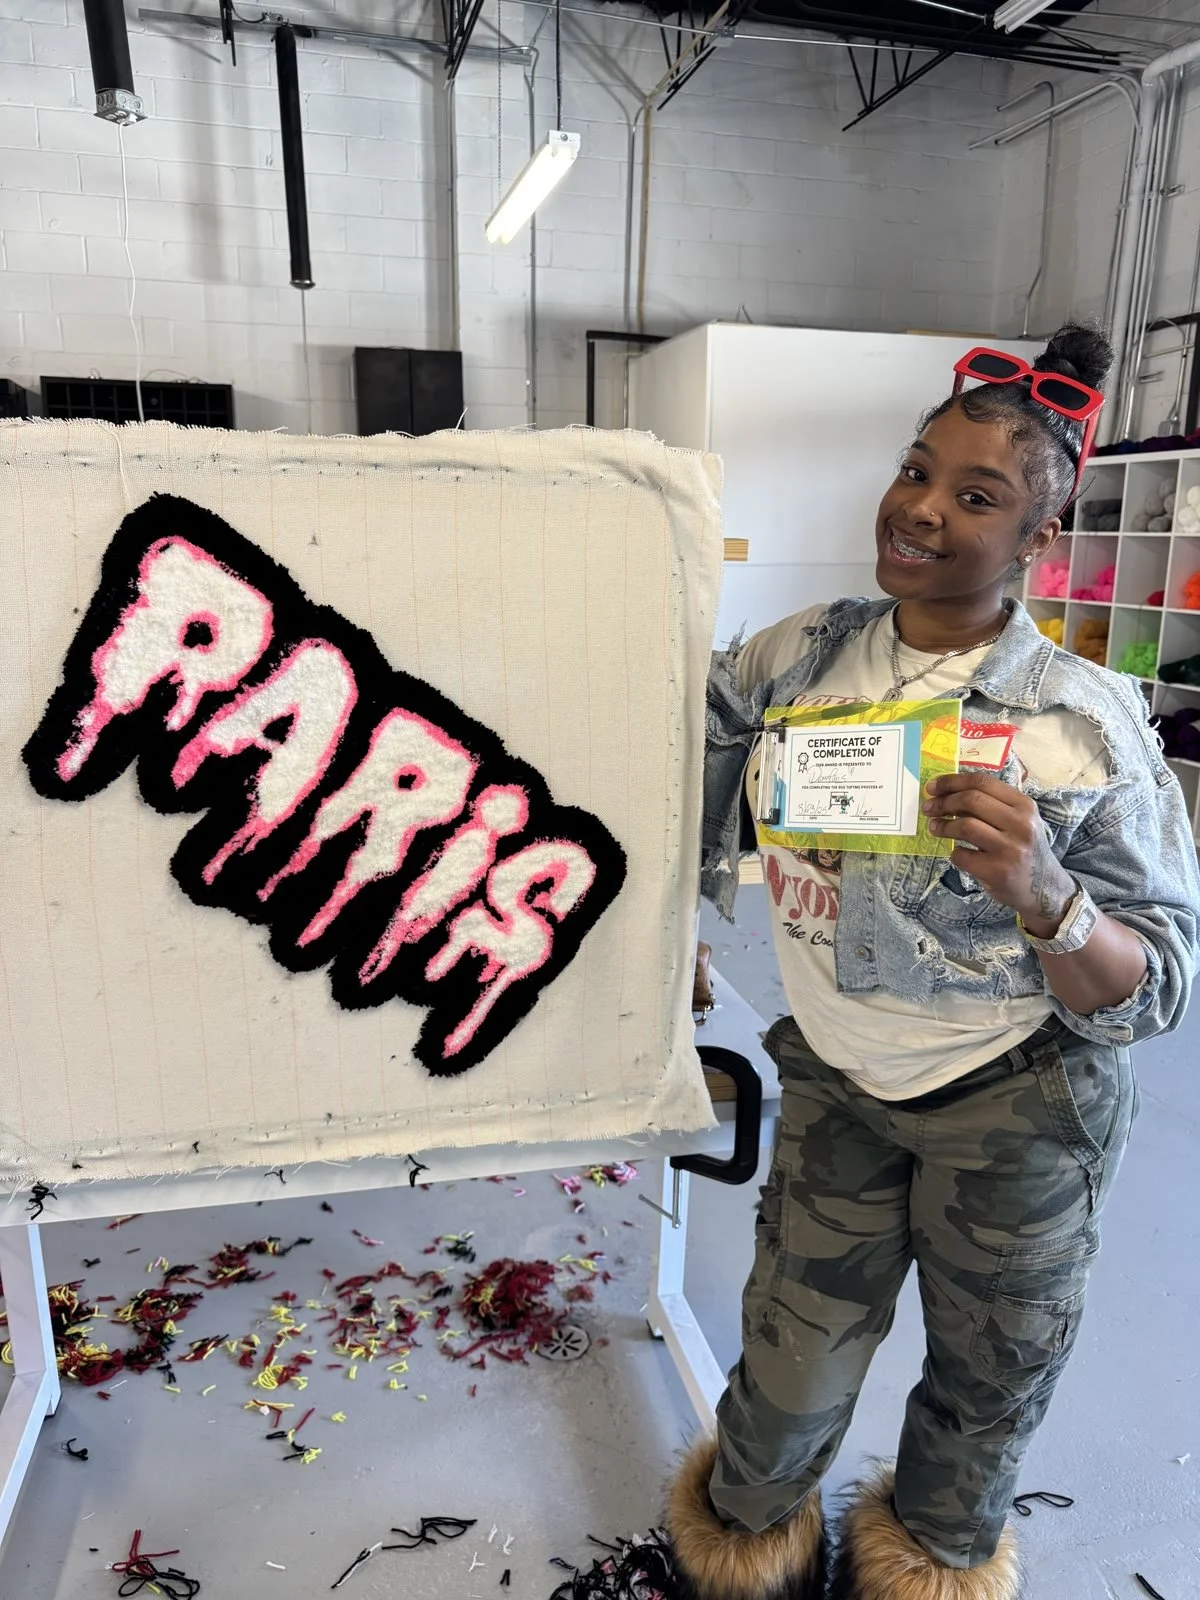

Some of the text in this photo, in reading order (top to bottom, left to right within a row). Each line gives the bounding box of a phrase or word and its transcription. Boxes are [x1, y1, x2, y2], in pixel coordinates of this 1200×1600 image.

[807, 736, 882, 748] CERTIFICATE OF
[813, 748, 875, 758] COMPLETION
[782, 922, 806, 939] The
